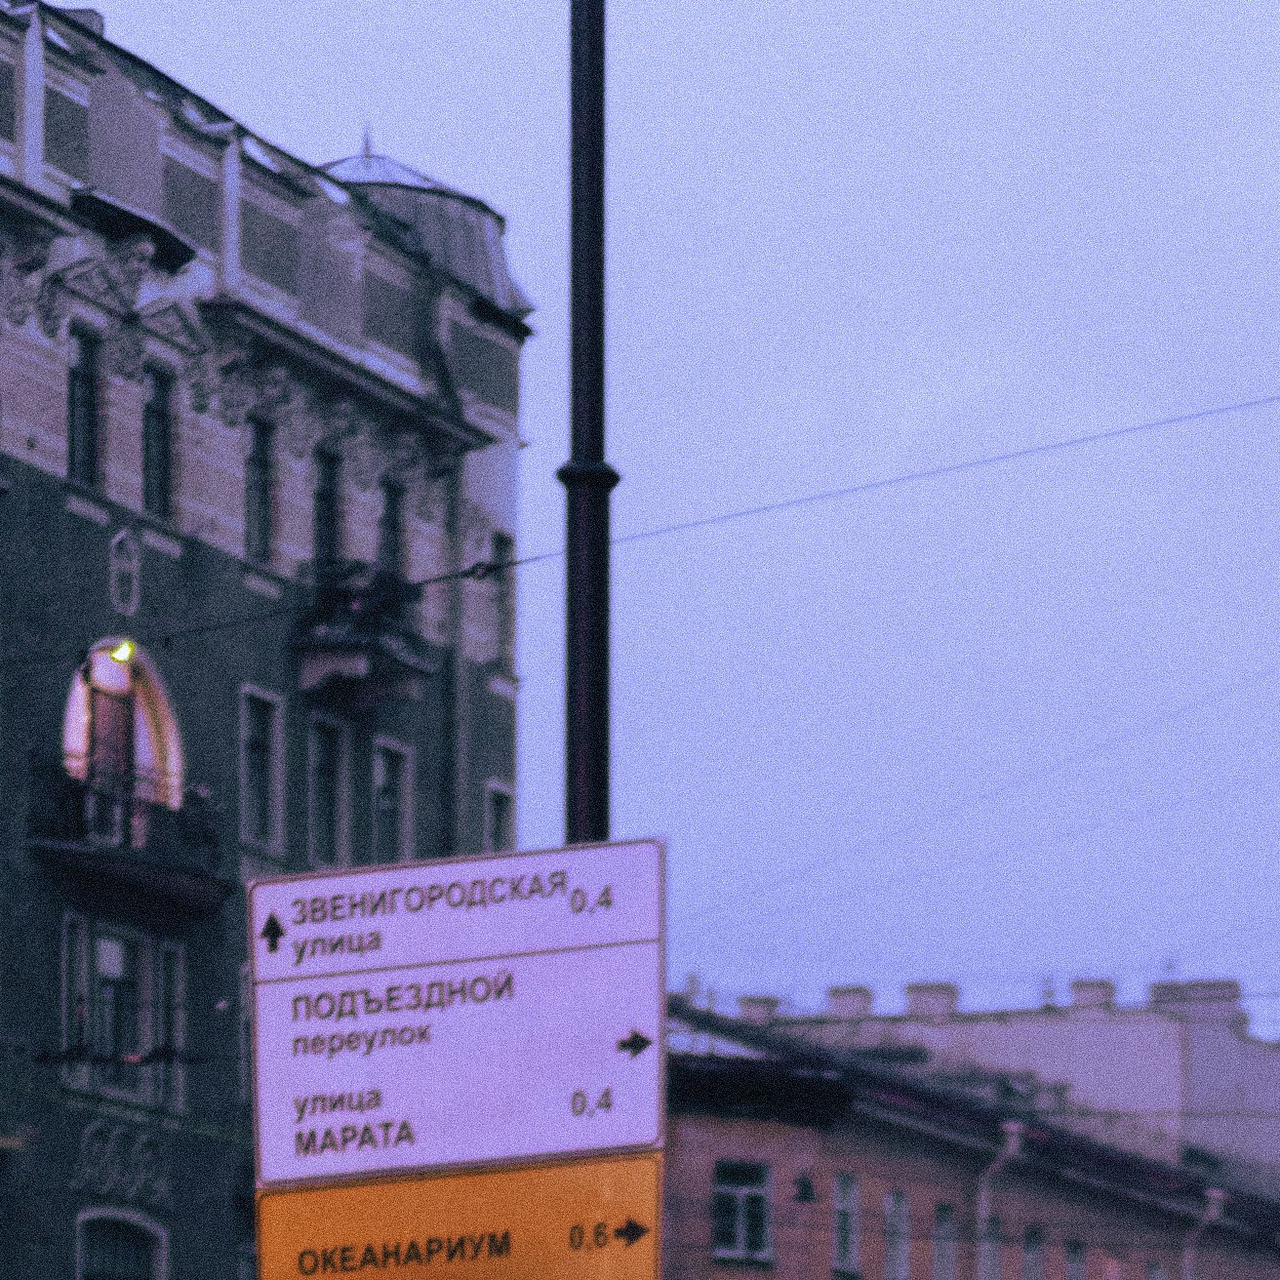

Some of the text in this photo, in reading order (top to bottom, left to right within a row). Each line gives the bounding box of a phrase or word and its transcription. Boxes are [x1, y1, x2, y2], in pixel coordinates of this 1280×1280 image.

[291, 870, 567, 926] ЗВЕНИГОРОДСКАЯ
[570, 885, 613, 915] 0,4
[291, 930, 382, 967] улица
[291, 968, 514, 1022] ПОДЪЕЗДНОЙ
[292, 1024, 431, 1060] переулок
[294, 1089, 382, 1123] улица
[571, 1086, 612, 1117] 0,4
[295, 1120, 416, 1156] МАРАТА
[297, 1230, 512, 1276] ОКЕАНАРИУМ
